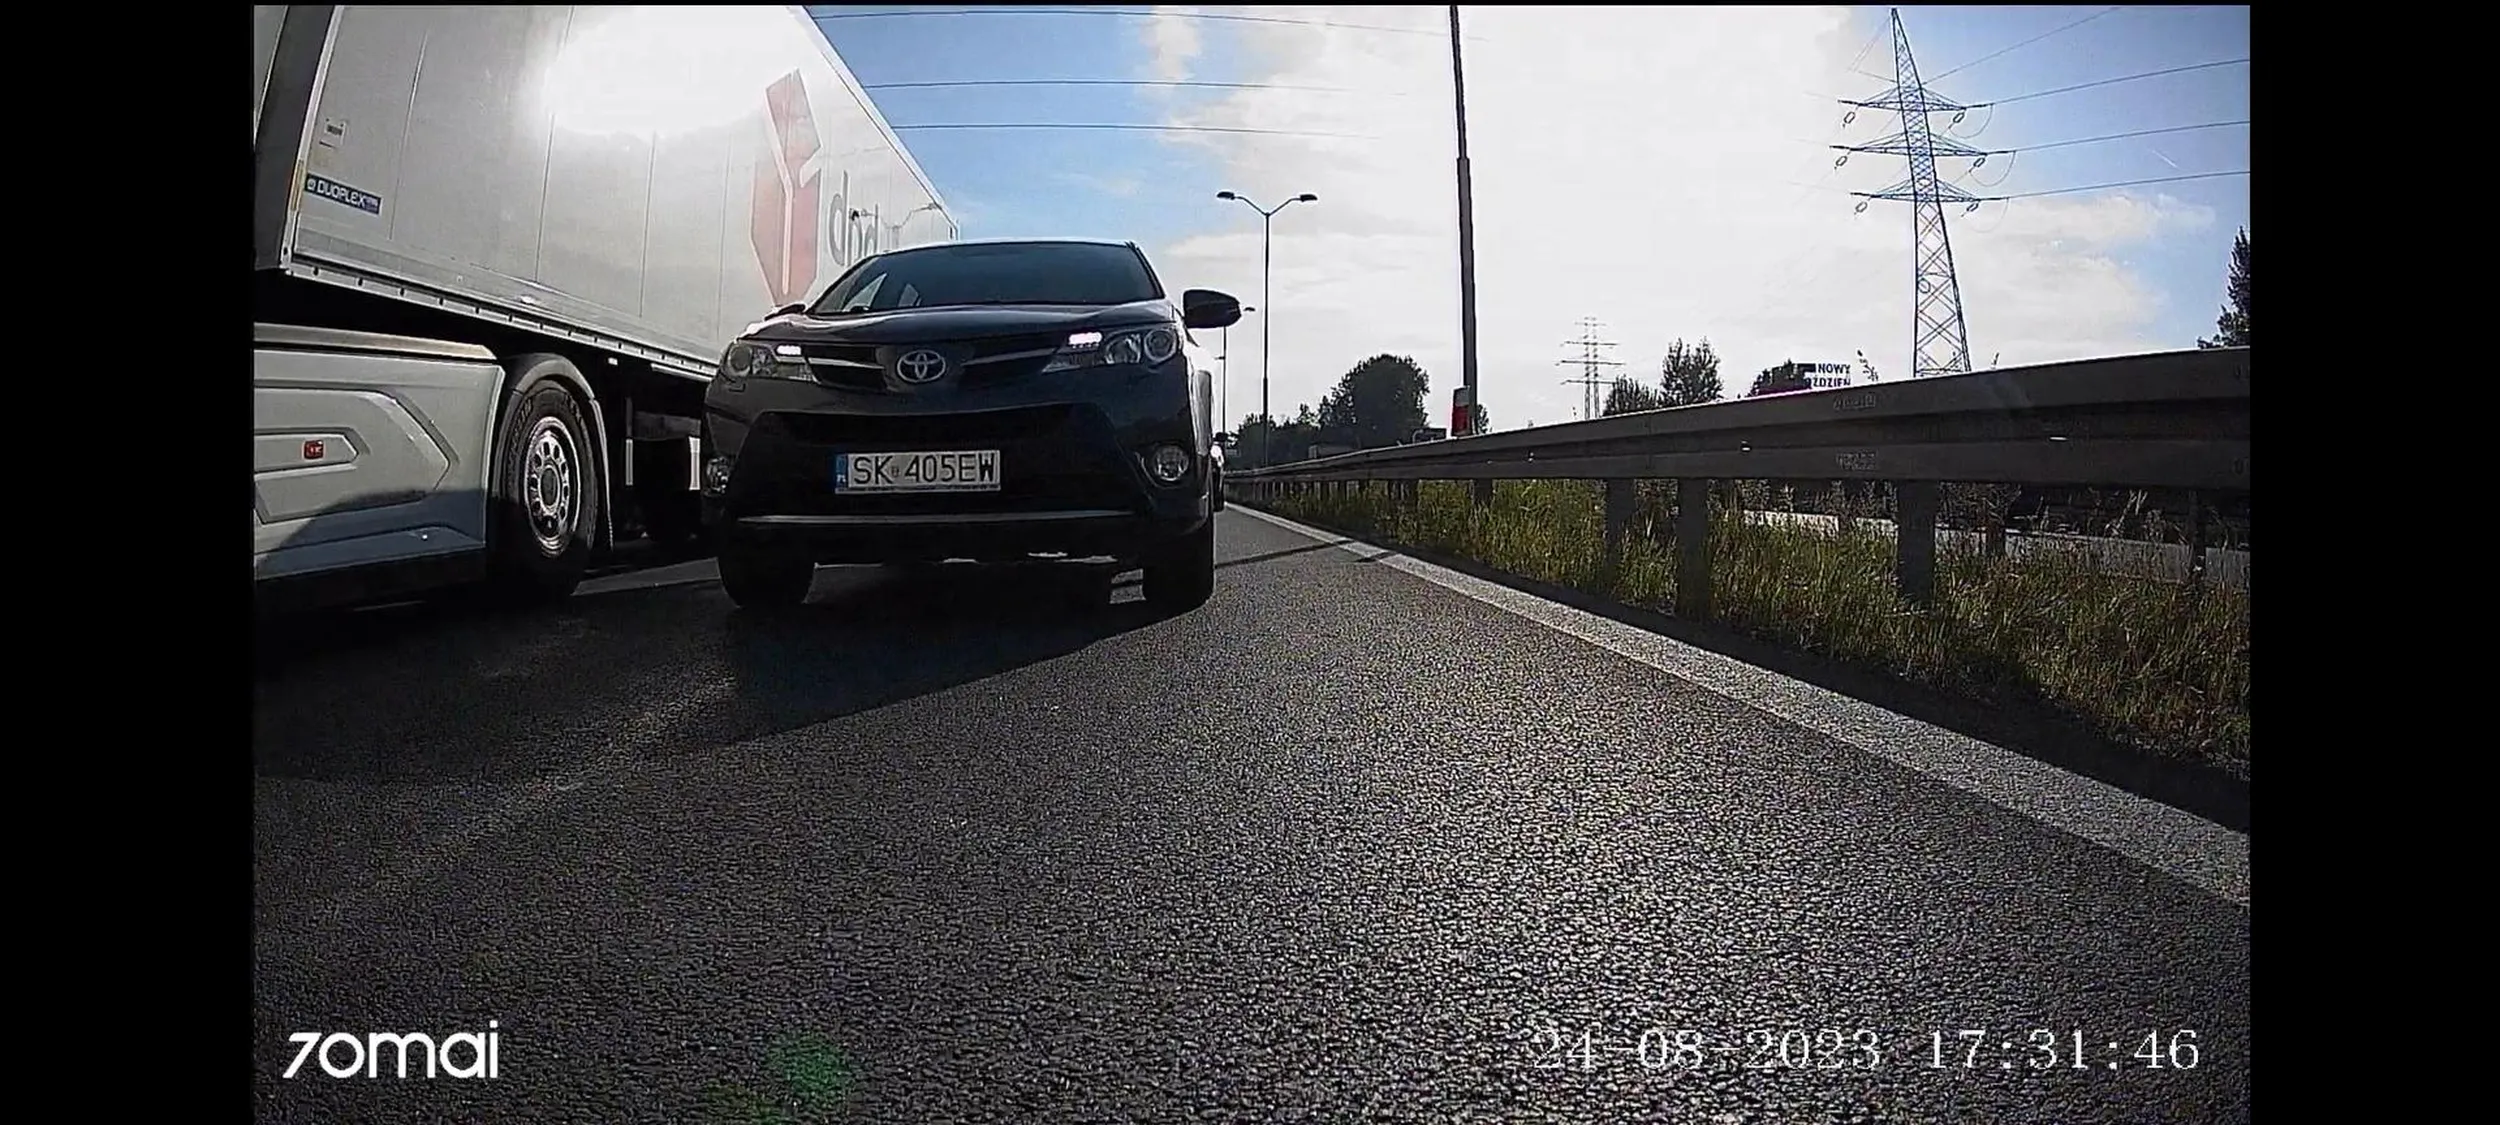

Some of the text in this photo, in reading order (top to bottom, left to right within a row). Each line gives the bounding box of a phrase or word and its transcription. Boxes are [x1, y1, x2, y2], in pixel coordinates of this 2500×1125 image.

[317, 180, 366, 208] DUOPLEX
[1818, 363, 1851, 374] NOWY
[853, 452, 995, 485] SK 405EW
